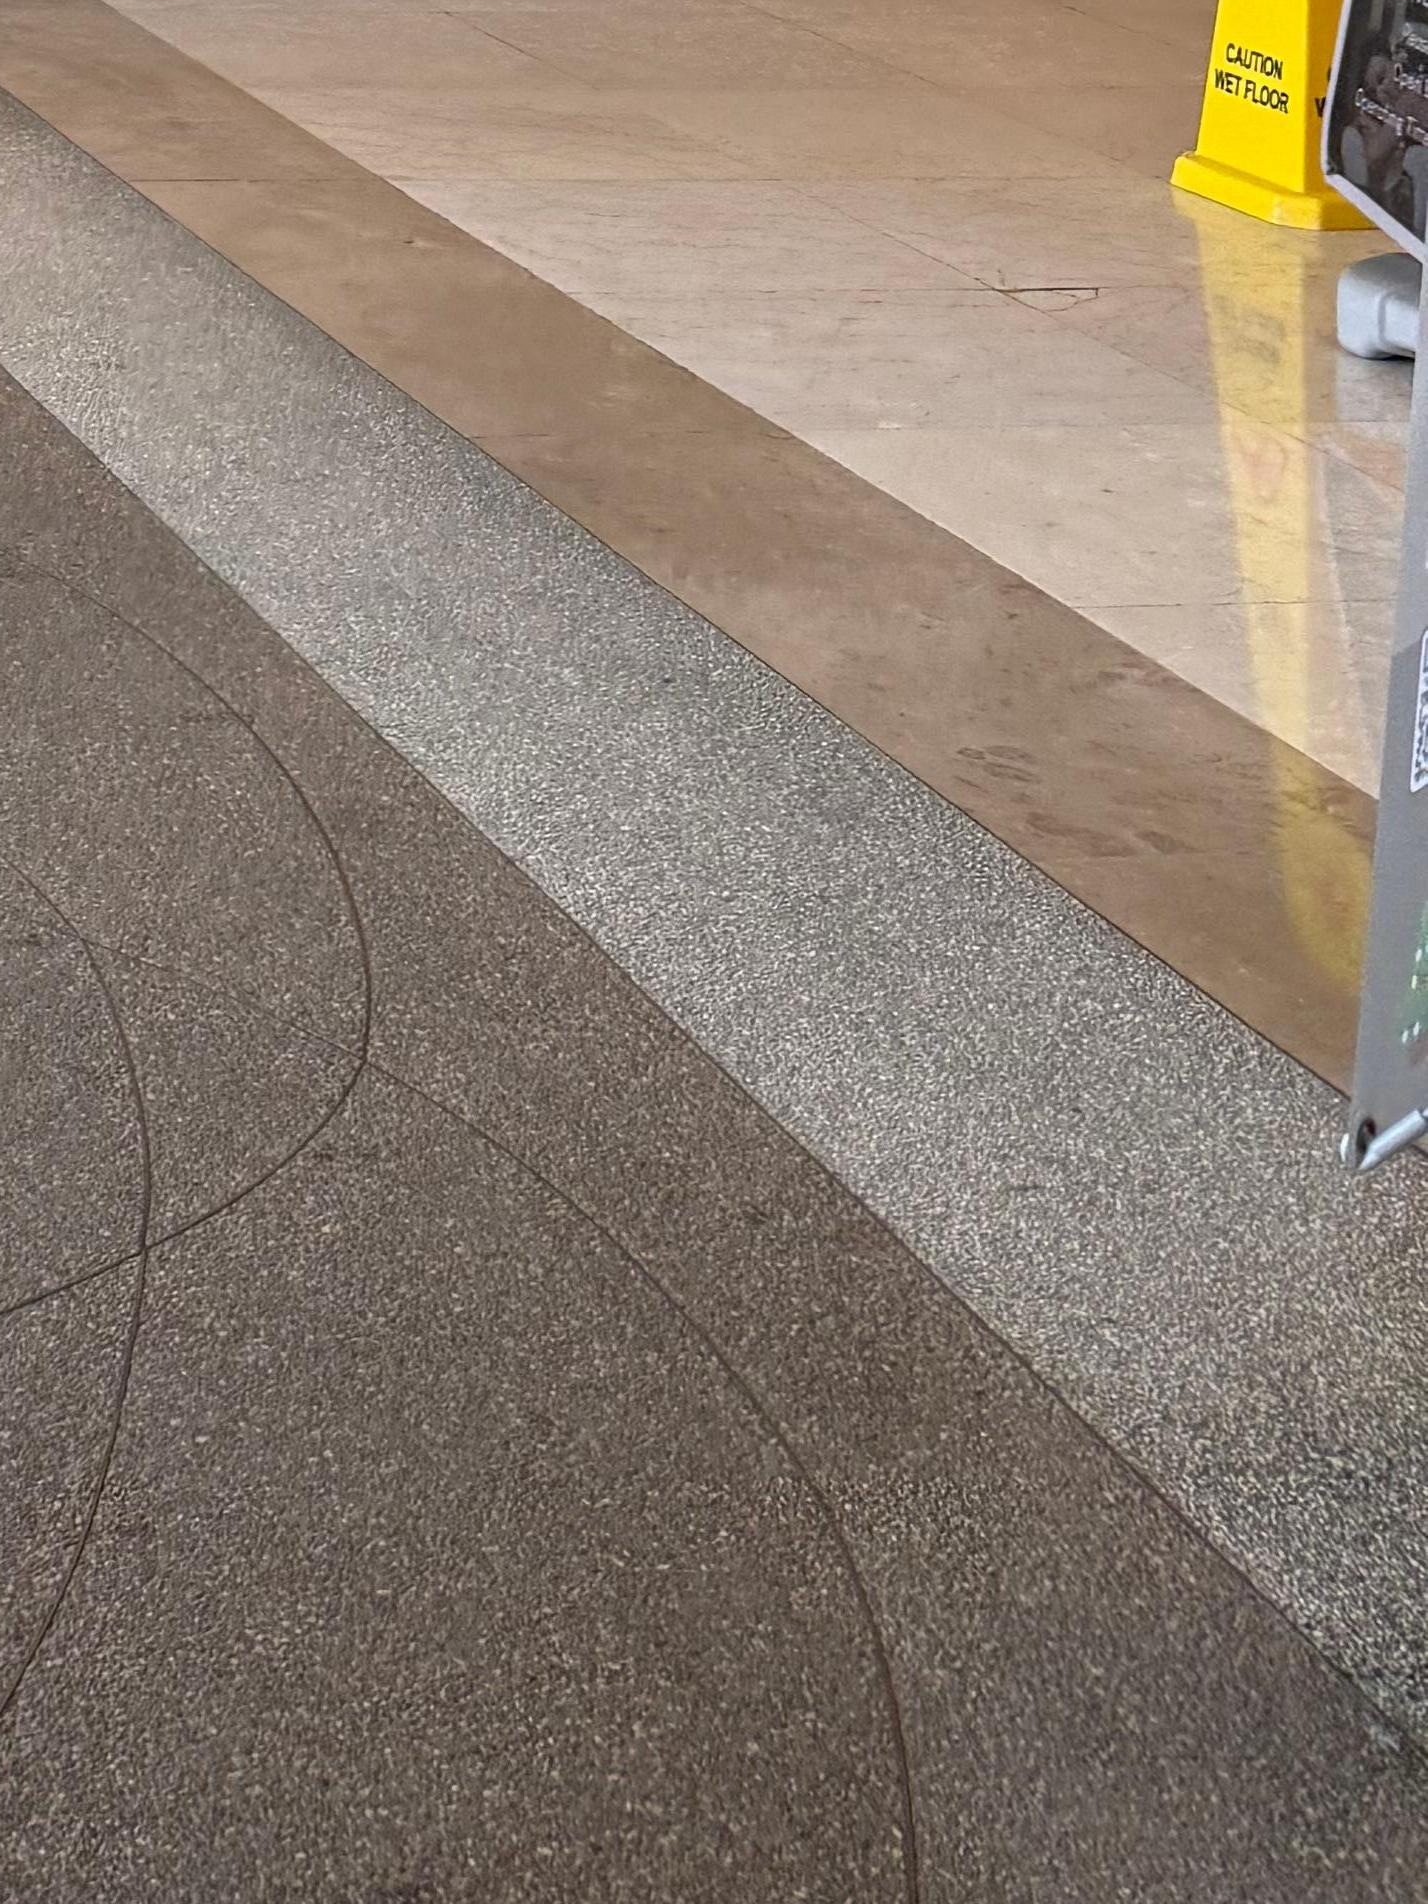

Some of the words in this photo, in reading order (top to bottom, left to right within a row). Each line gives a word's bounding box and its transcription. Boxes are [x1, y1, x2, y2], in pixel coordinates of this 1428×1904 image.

[1226, 42, 1283, 80] CAUTION
[1214, 67, 1242, 96] WET
[1243, 79, 1289, 114] FLOOR
